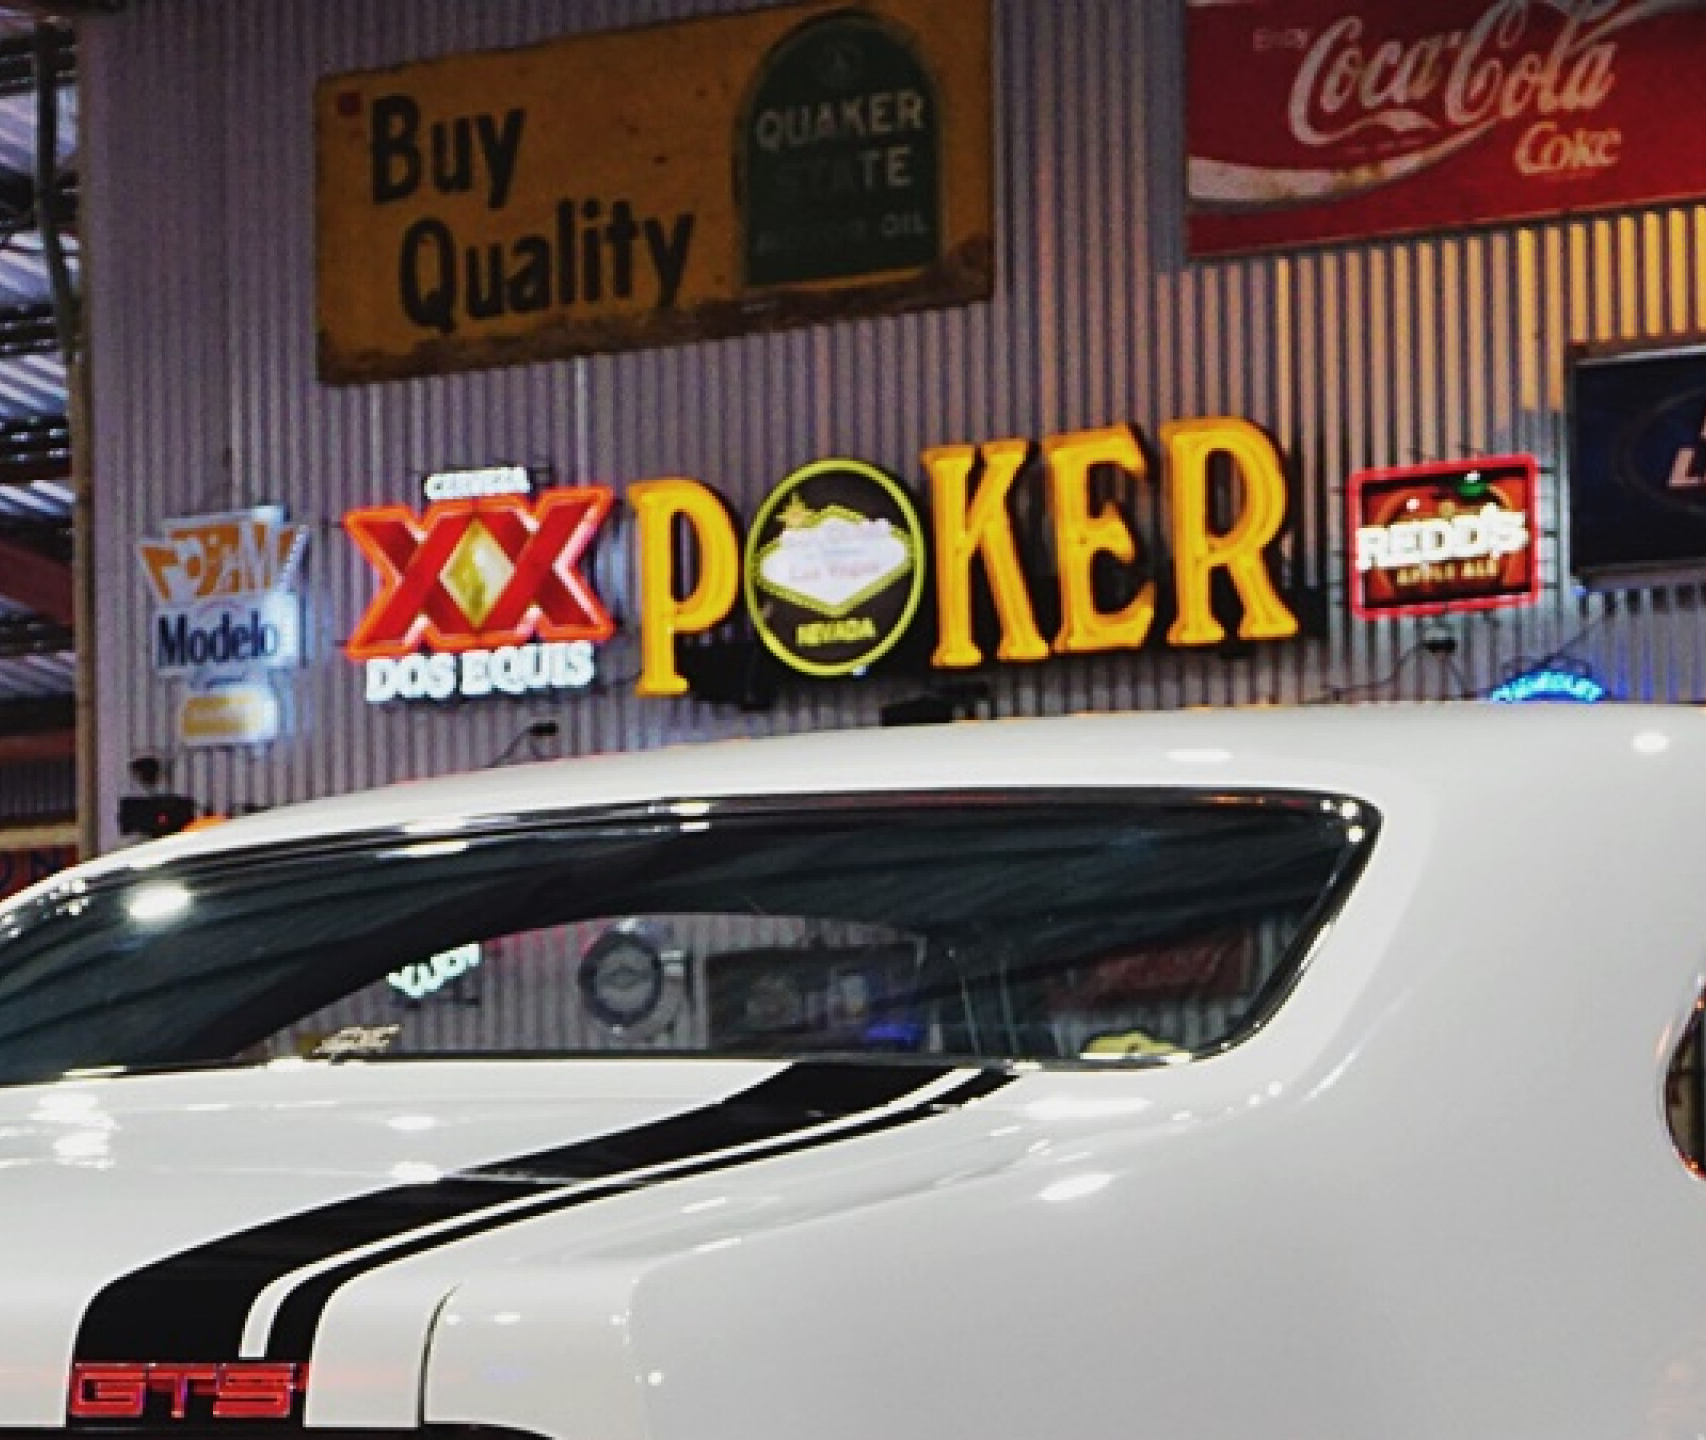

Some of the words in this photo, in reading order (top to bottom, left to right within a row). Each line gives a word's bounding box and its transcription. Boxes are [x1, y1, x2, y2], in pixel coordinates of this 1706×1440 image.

[1288, 0, 1618, 146] Coca-Cola
[372, 94, 526, 211] Buy
[756, 88, 925, 154] QUAKER
[1514, 120, 1622, 176] Coke
[400, 196, 695, 334] Quality
[343, 486, 613, 662] XX
[627, 415, 1298, 697] POKER
[157, 610, 280, 667] Modelo
[366, 652, 455, 704] DOS
[461, 639, 595, 695] EQUIS
[71, 1362, 296, 1418] GTS
